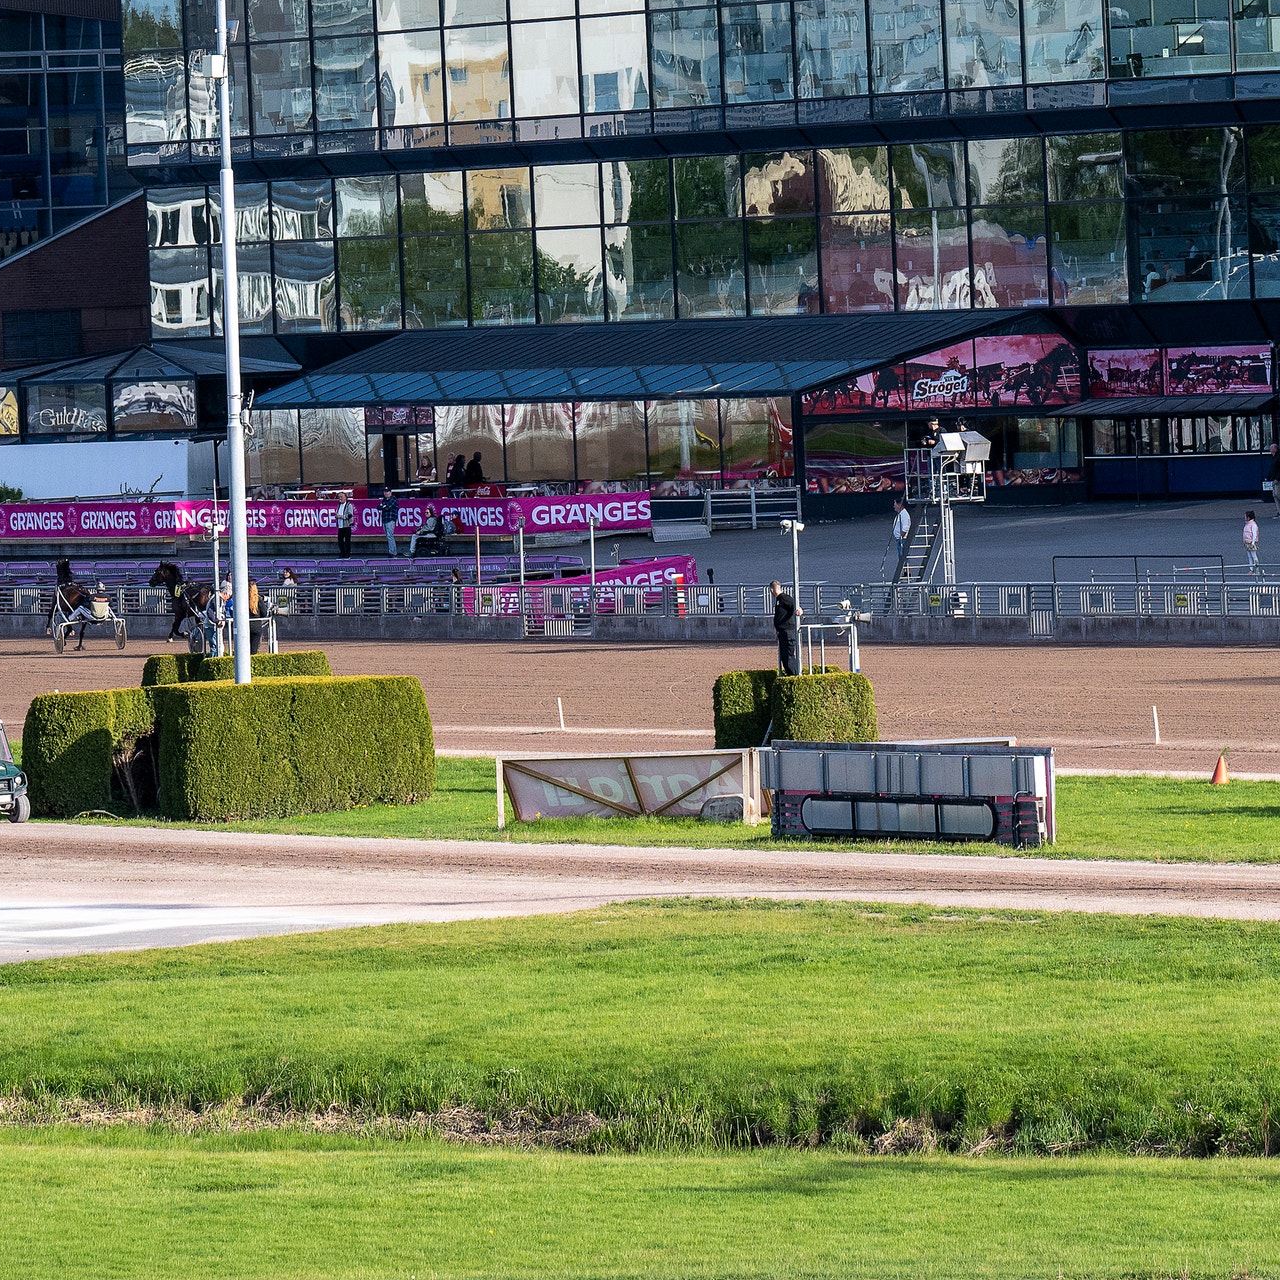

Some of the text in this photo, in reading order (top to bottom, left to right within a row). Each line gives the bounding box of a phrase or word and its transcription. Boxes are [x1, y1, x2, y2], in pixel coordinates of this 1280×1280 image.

[915, 379, 967, 398] Ströget
[9, 511, 64, 531] GRÄNGES
[81, 510, 136, 529] GRÄNGES
[284, 508, 336, 528] GRÄNGE
[362, 507, 422, 527] GRGES
[441, 507, 504, 526] GÄNGES
[532, 500, 651, 525] GRÄNGES
